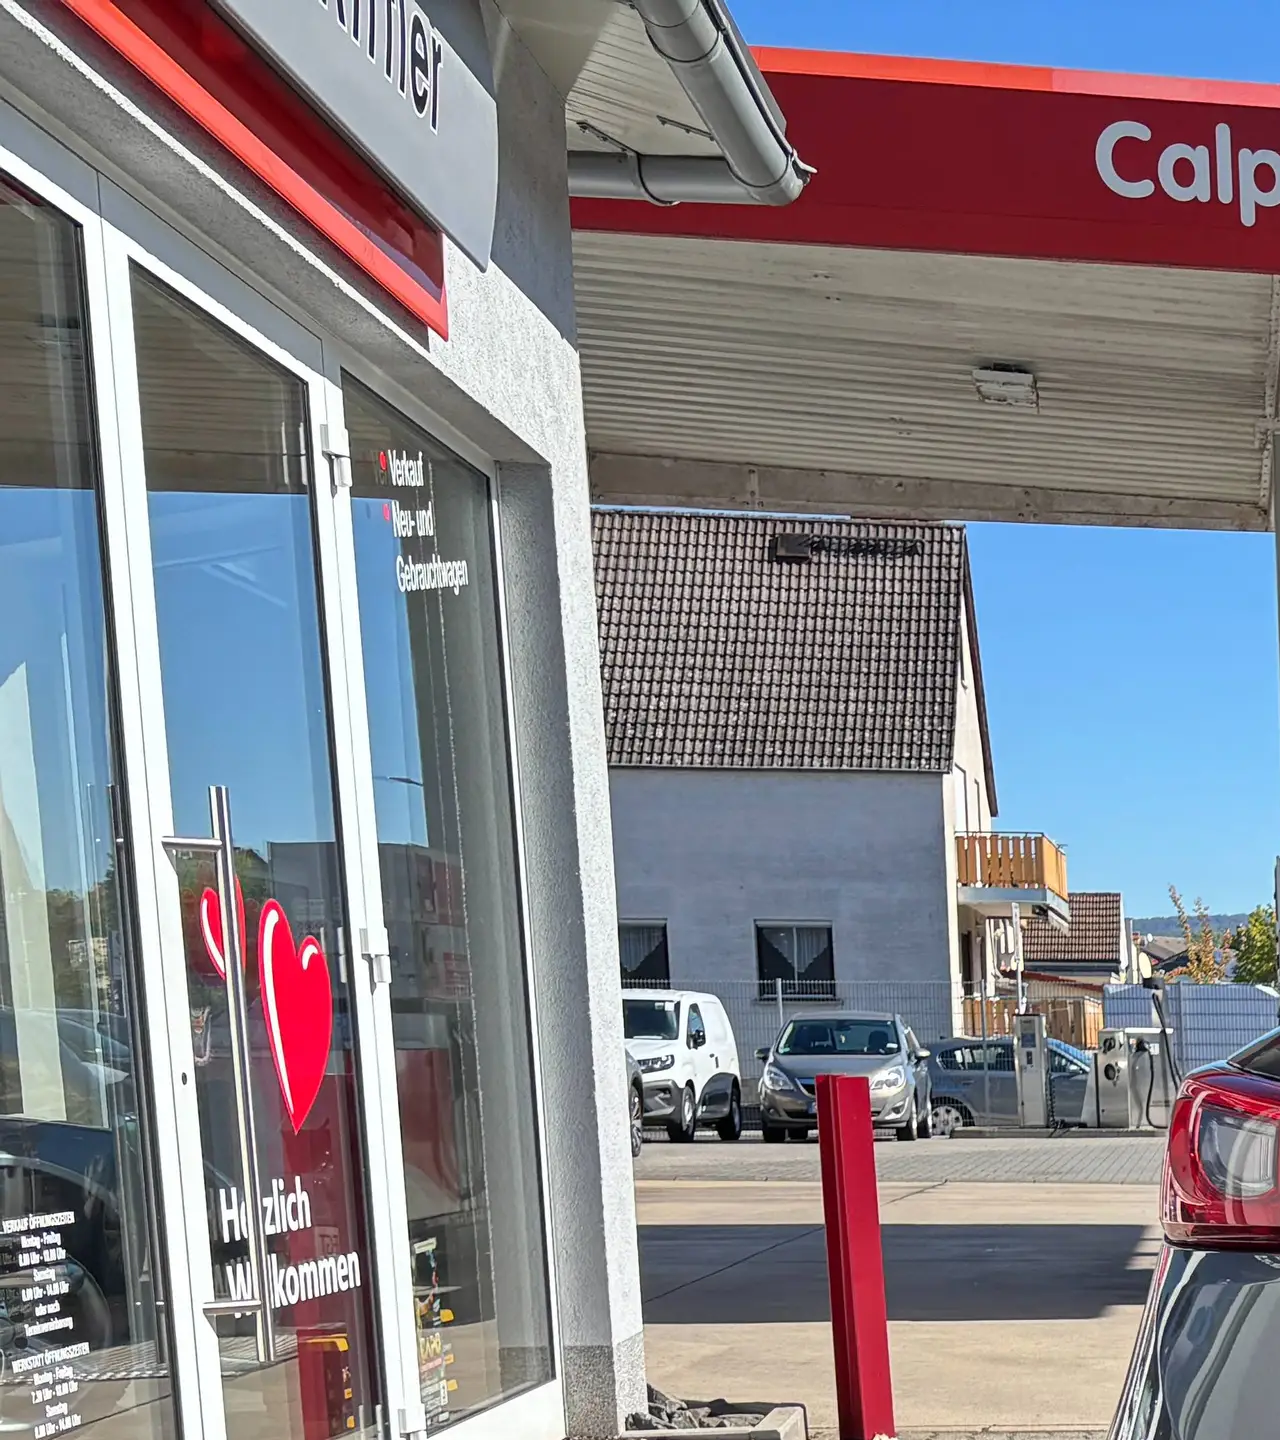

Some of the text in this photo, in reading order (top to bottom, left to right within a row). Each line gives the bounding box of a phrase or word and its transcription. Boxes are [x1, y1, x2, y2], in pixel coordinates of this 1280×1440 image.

[388, 449, 424, 487] Verkauf
[392, 500, 434, 538] Neu- und
[396, 554, 469, 596] Gebrauchtwagen
